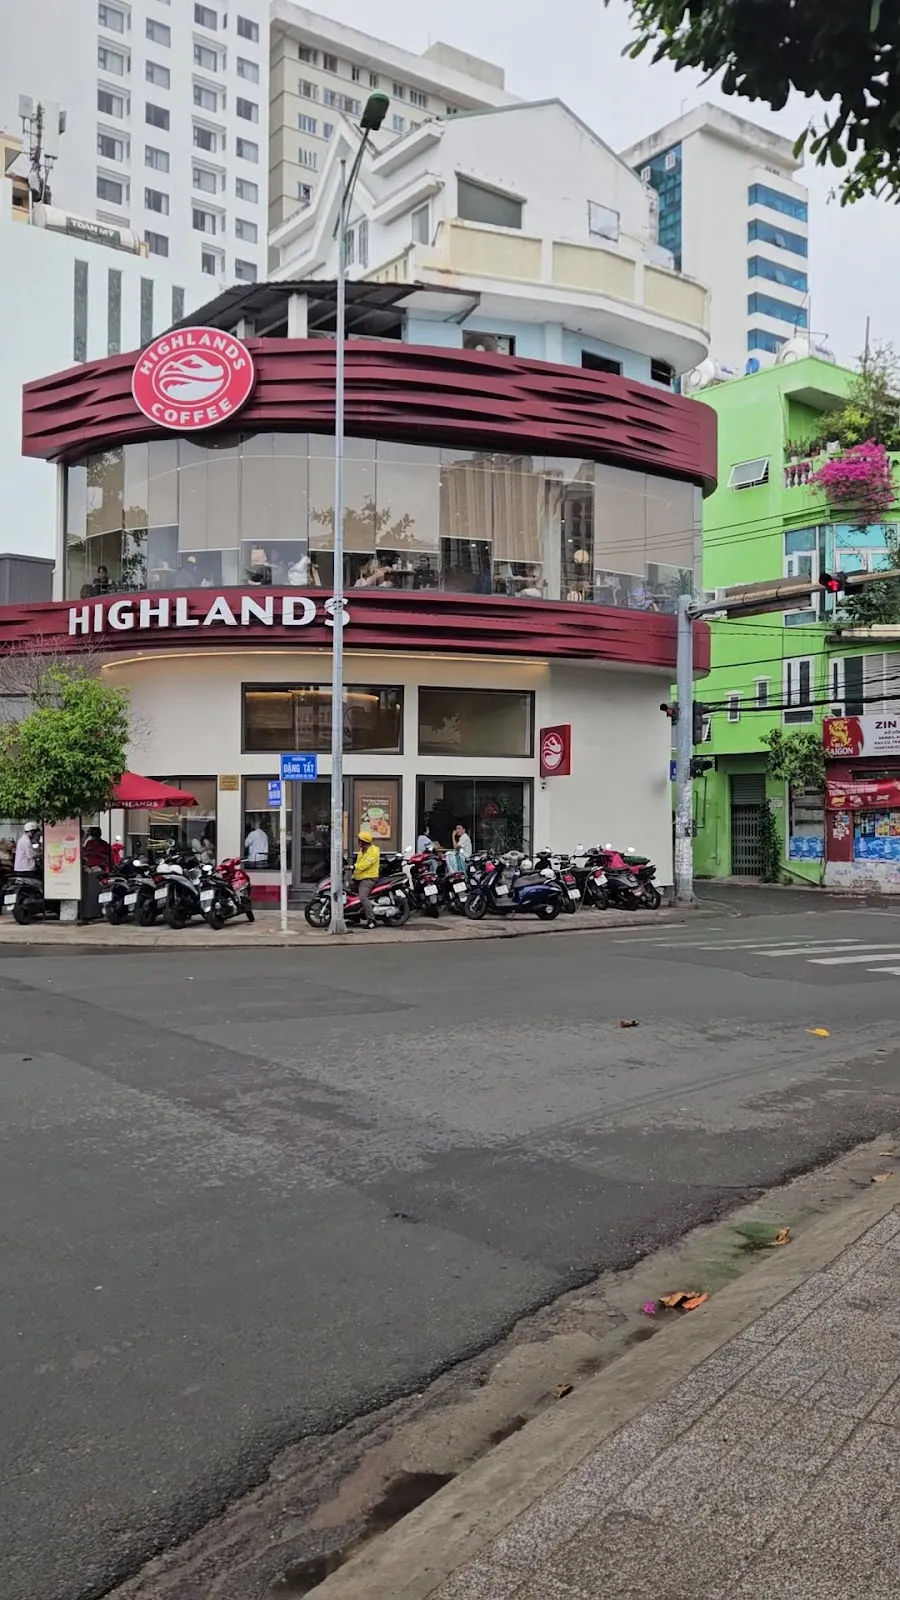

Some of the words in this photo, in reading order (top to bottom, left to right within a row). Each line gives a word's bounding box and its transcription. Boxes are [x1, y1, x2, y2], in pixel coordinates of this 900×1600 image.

[139, 333, 246, 375] HIGHLANDS
[151, 397, 232, 424] COFFEE
[68, 595, 350, 636] HIGHLANDS
[875, 720, 897, 730] ZIN
[825, 746, 854, 756] SAIGON
